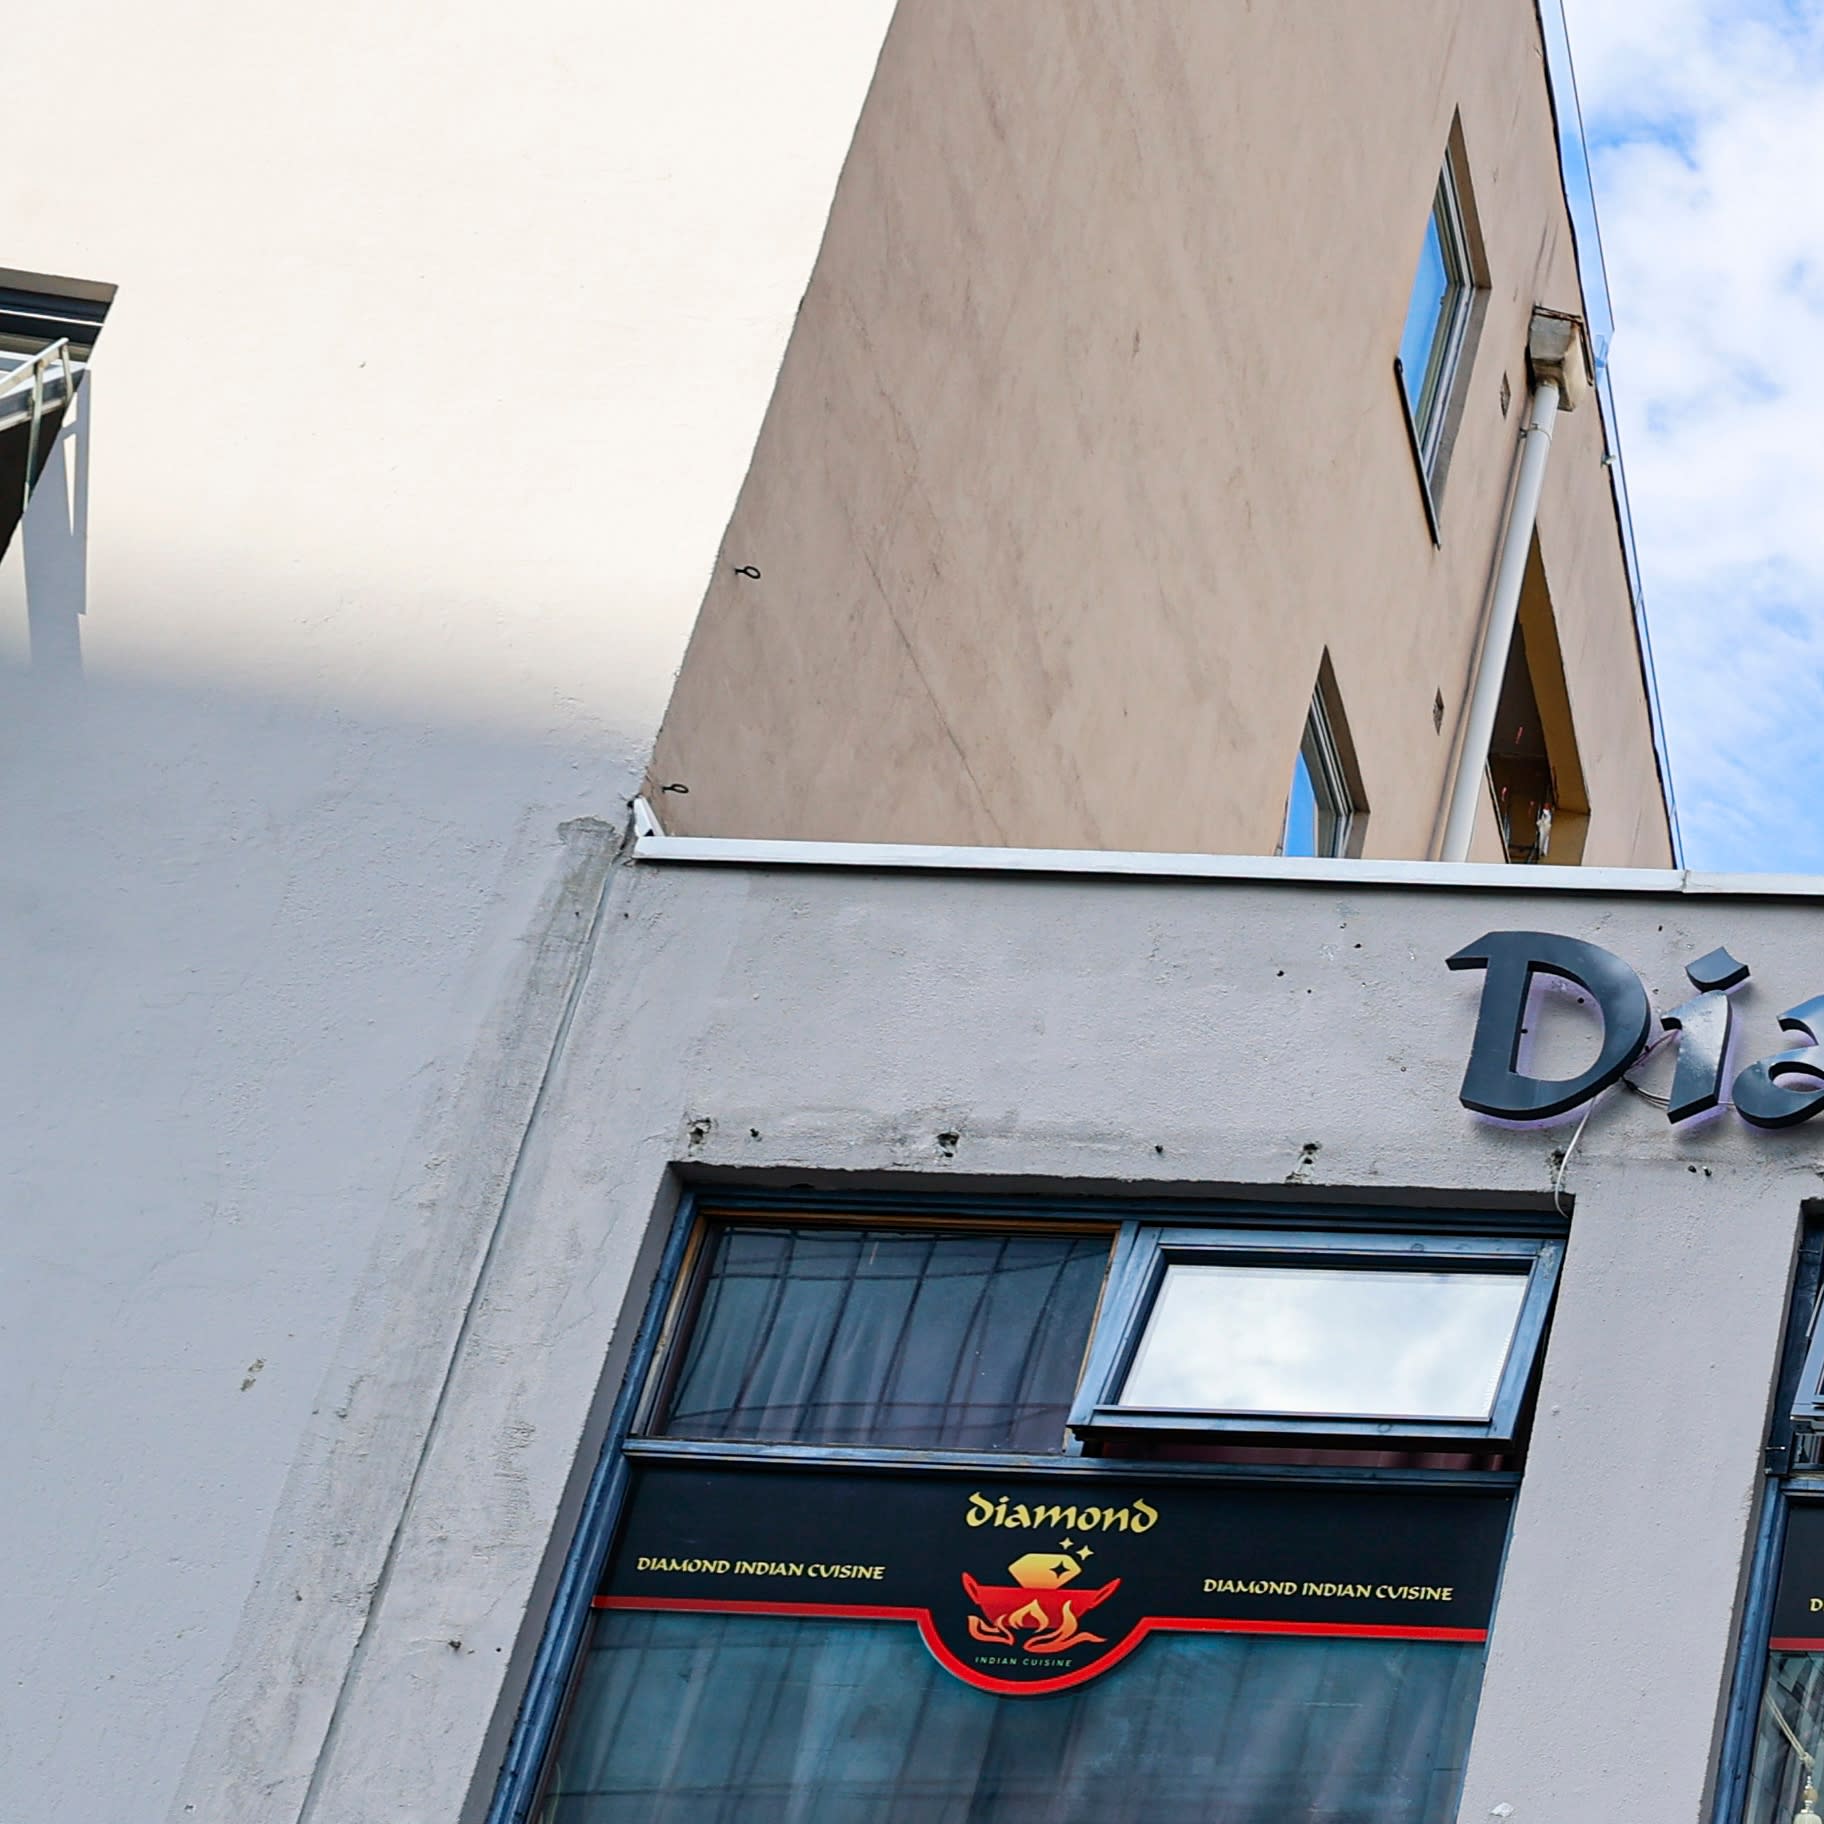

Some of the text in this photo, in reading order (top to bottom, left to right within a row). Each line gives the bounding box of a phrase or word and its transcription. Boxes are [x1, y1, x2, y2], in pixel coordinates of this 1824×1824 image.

[966, 1491, 1158, 1533] diamond
[637, 1557, 886, 1580] DIAMOND INDIAN CUISINE
[1203, 1578, 1454, 1601] DIAMOND INDIAN CUISINE
[975, 1656, 1072, 1667] INDIAN CUISINE
